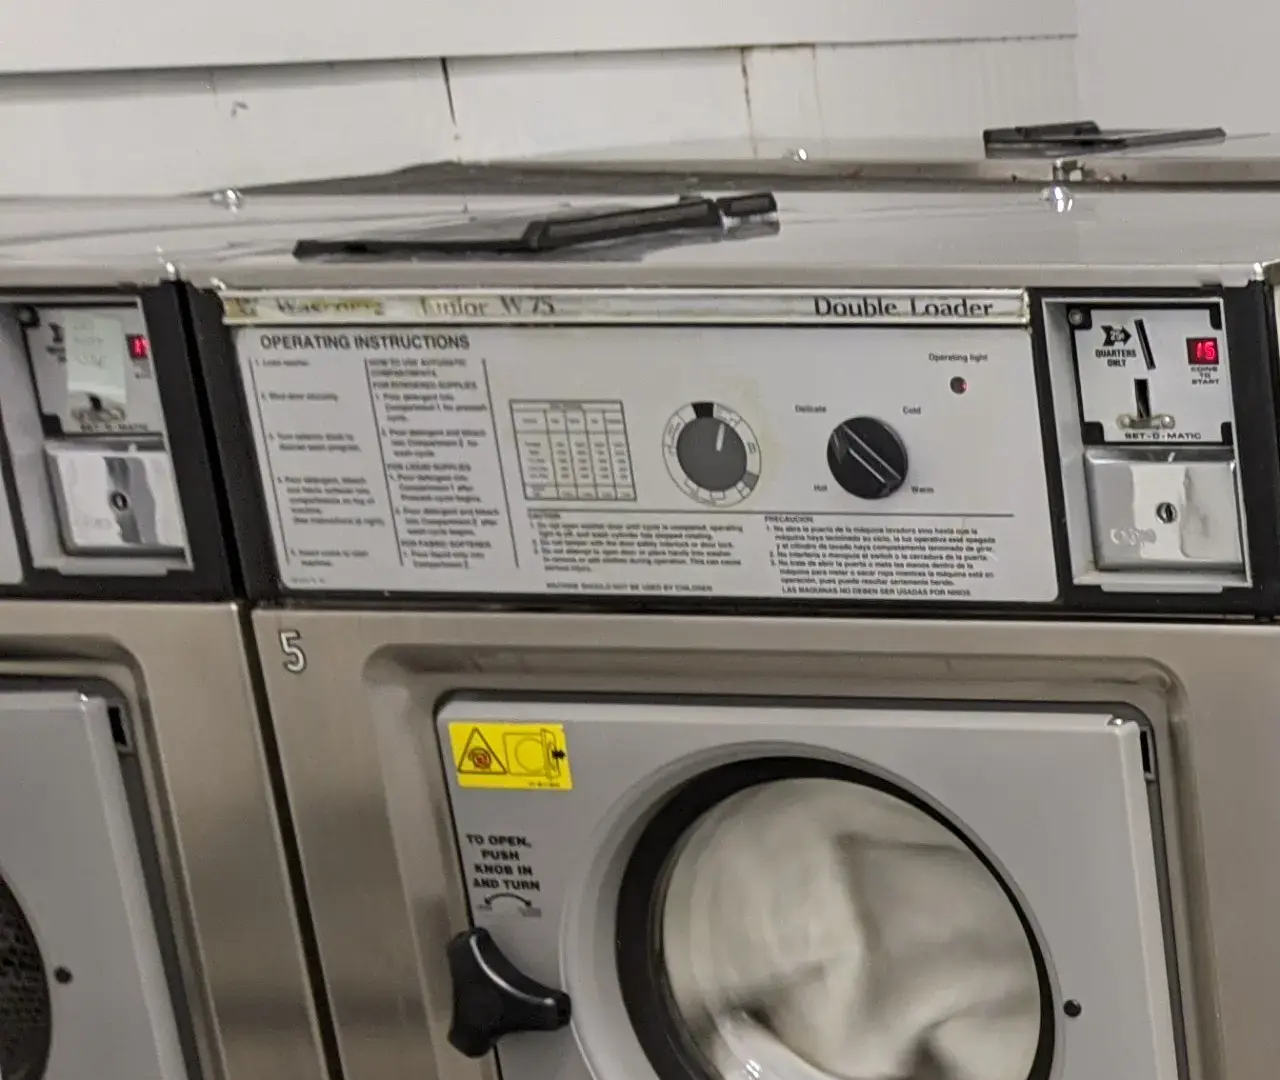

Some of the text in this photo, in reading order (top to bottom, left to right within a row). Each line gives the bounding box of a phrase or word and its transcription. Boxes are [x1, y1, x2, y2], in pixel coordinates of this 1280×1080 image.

[528, 297, 556, 315] 75
[814, 296, 993, 317] Double Loader
[261, 335, 469, 350] OPERATING INSTRUCTIONS
[1195, 342, 1215, 360] 15
[280, 631, 307, 674] 5
[466, 834, 531, 848] TO OPEN,
[481, 850, 519, 861] PUSH
[474, 864, 533, 876] KNOB IN
[473, 878, 540, 891] AND TURN
